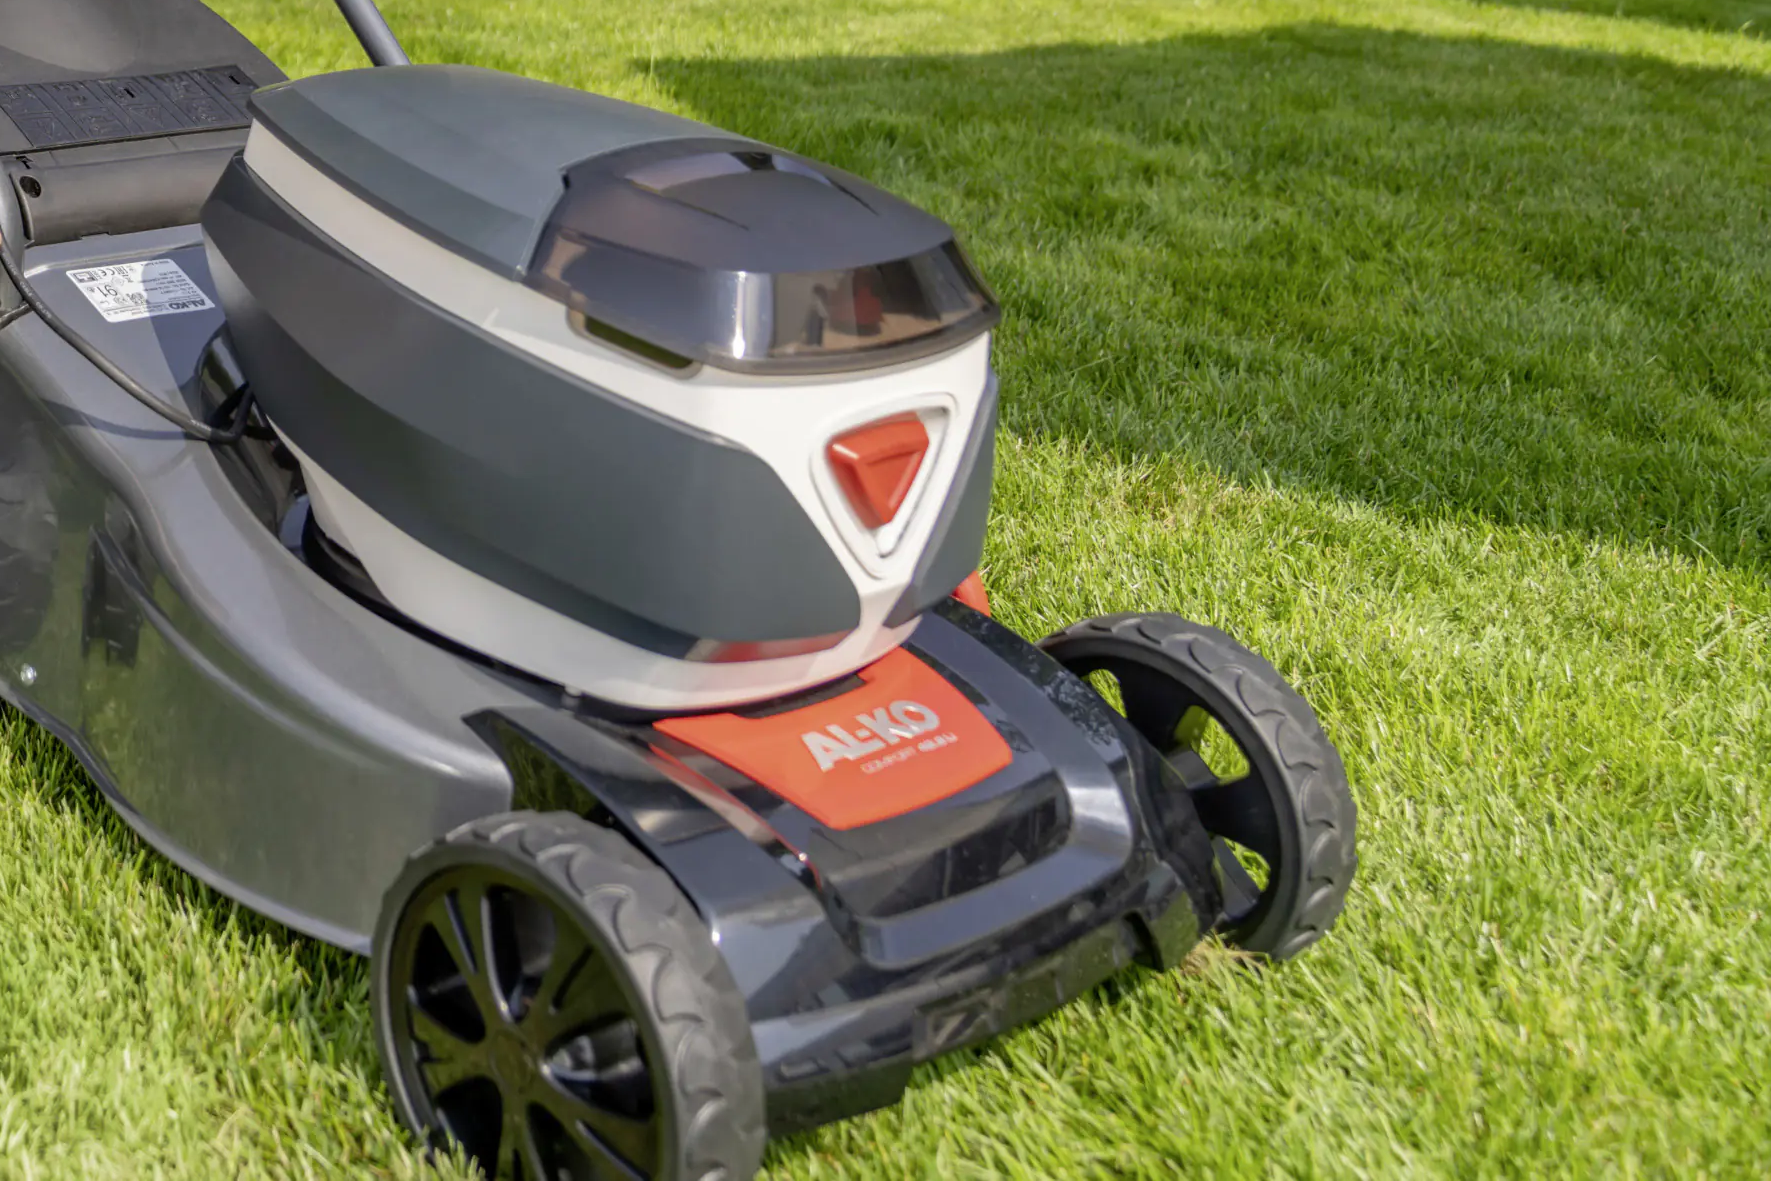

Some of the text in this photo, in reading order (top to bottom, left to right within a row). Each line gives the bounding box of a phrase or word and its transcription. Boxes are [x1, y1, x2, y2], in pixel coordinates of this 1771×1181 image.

[96, 285, 118, 298] 91
[168, 298, 207, 310] AL-KO
[801, 700, 940, 772] AL-KO
